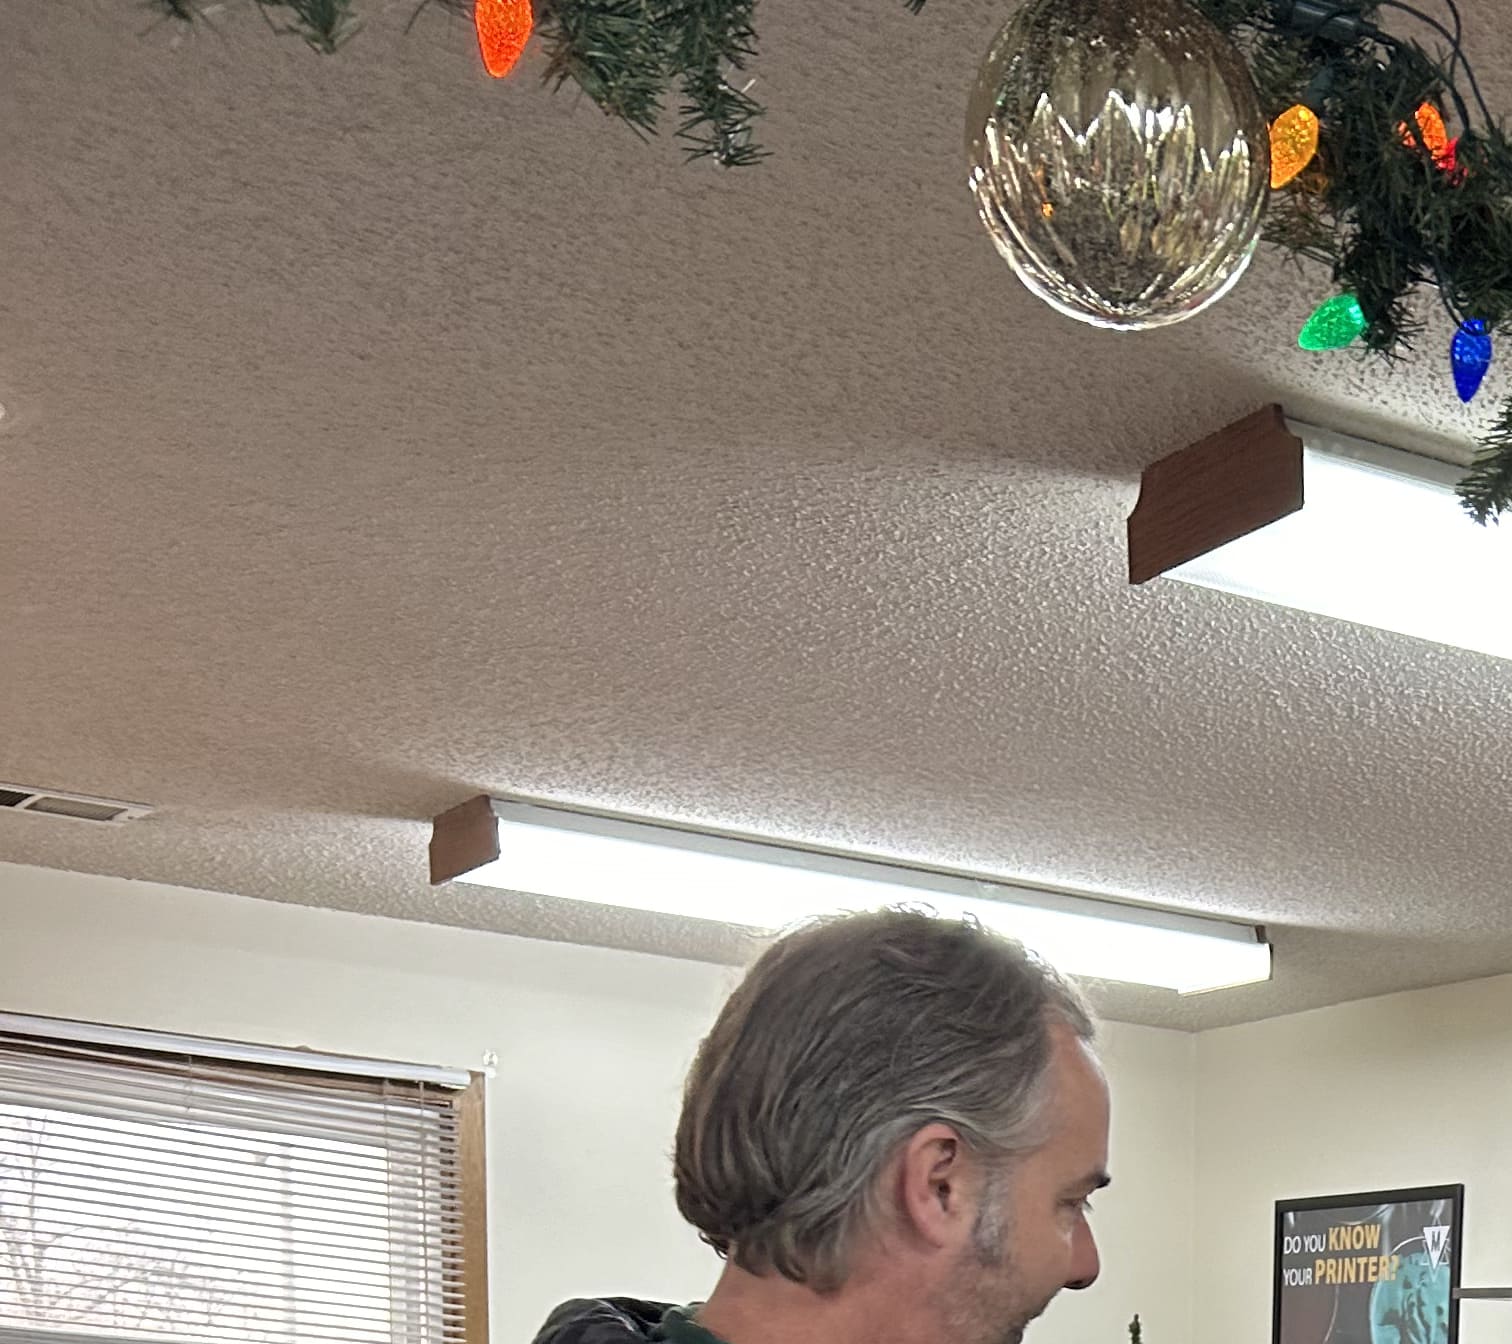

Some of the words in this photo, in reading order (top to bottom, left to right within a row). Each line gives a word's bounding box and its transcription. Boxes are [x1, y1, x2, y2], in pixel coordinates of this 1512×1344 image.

[1283, 1236, 1301, 1254] DO
[1303, 1234, 1326, 1253] YOU
[1328, 1224, 1381, 1251] KNOW
[1283, 1268, 1313, 1286] YOUR
[1314, 1254, 1399, 1285] PRINTER?
